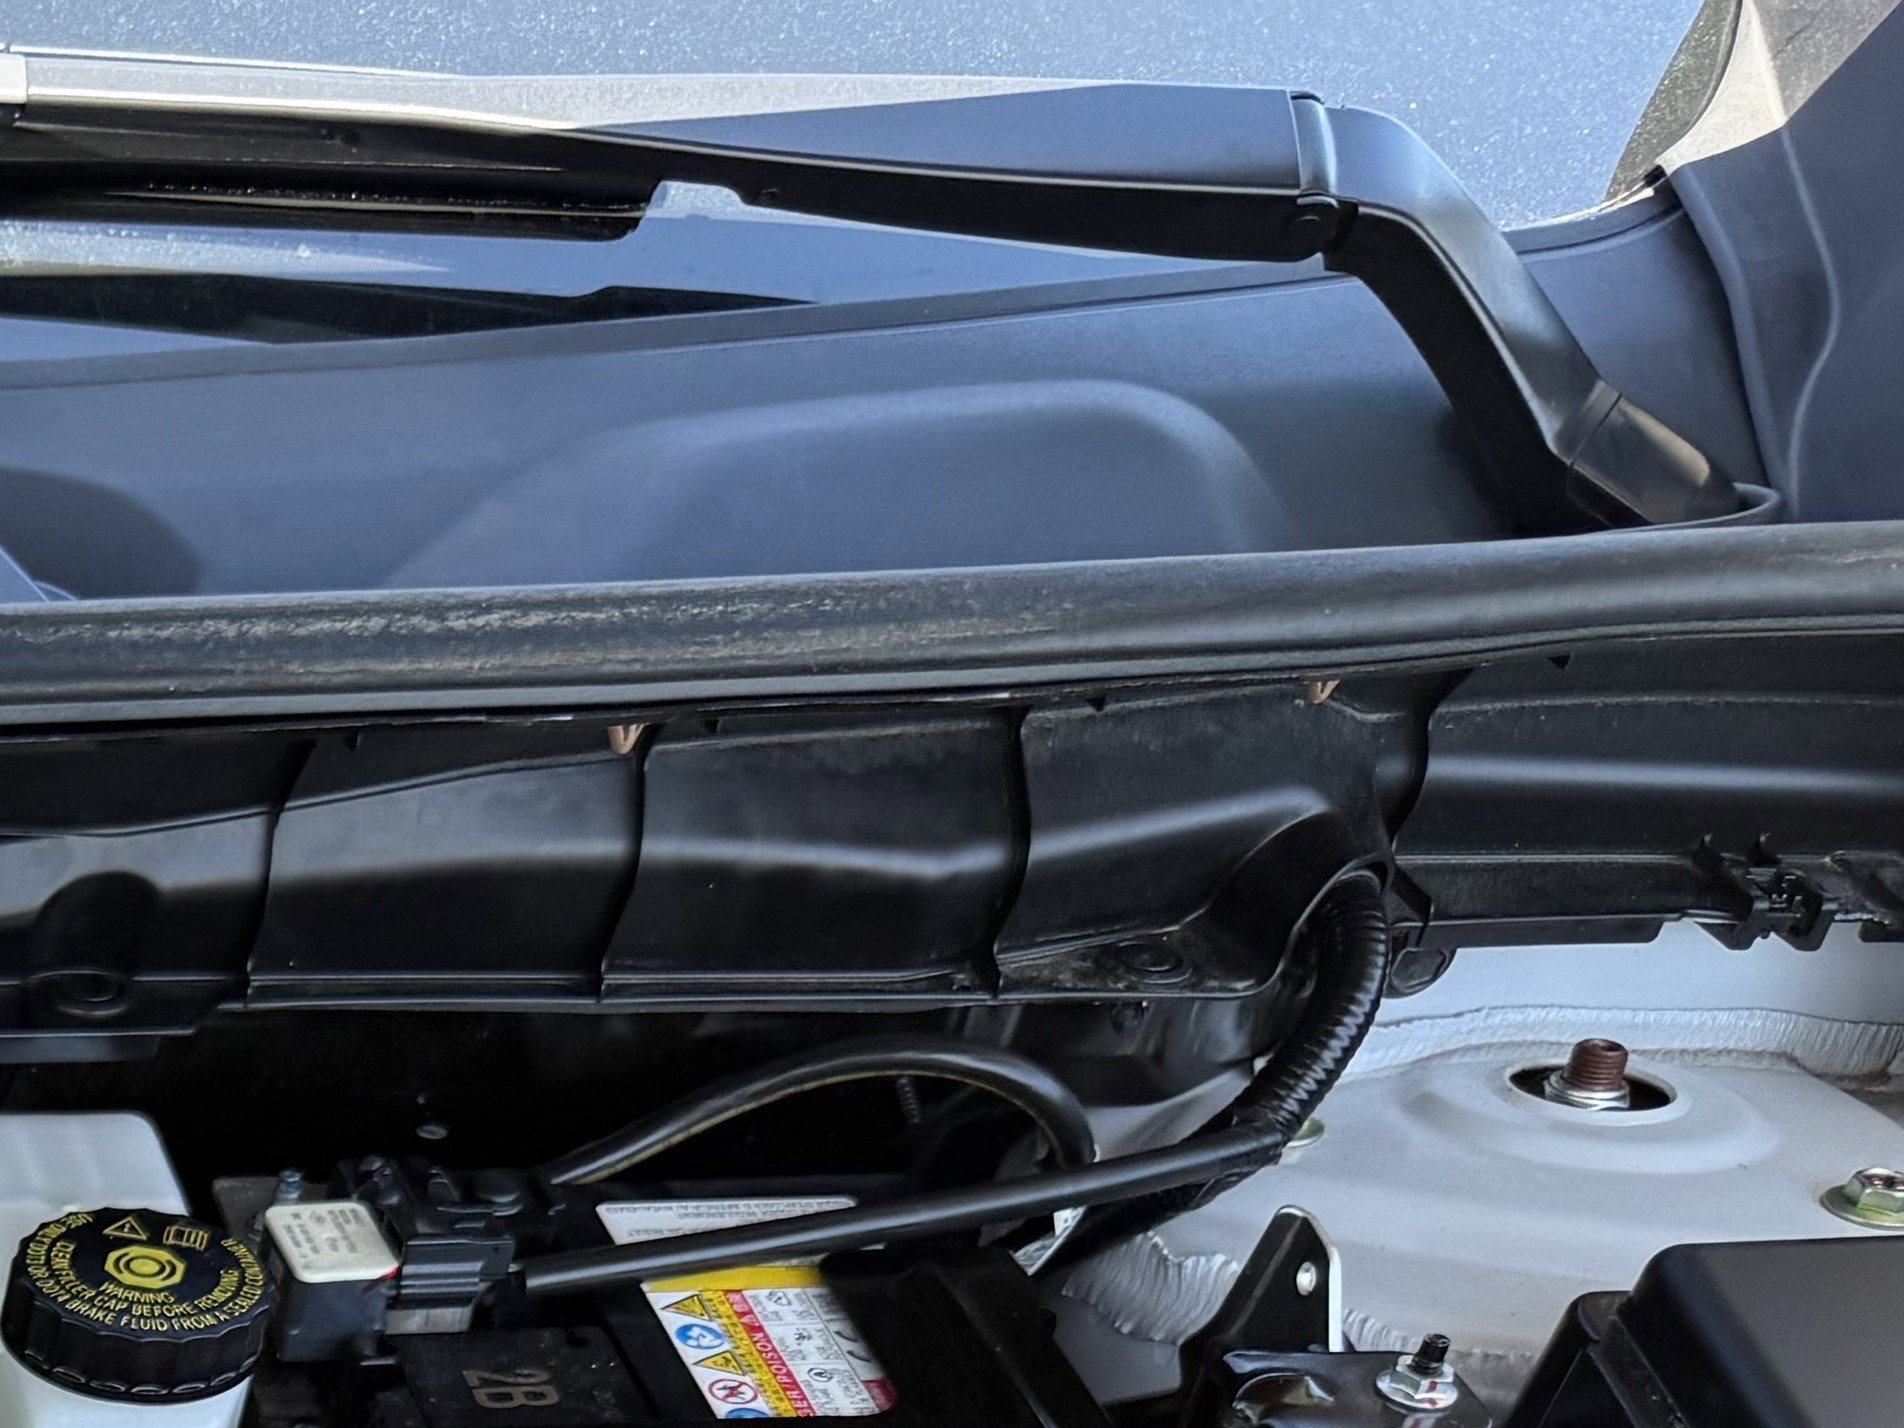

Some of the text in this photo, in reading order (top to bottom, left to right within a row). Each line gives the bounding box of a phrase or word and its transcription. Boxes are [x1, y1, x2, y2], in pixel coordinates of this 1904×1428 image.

[218, 1236, 263, 1286] CONTAINER
[53, 1270, 97, 1299] FILLER
[93, 1294, 128, 1313] CAP
[131, 1302, 196, 1317] BEFORE
[192, 1268, 239, 1311] REMOVING
[100, 1281, 174, 1303] WARNING
[221, 1285, 262, 1316] SEALED
[65, 1300, 117, 1325] BRAKE
[120, 1315, 168, 1331] FLUID
[173, 1313, 218, 1331] FROM
